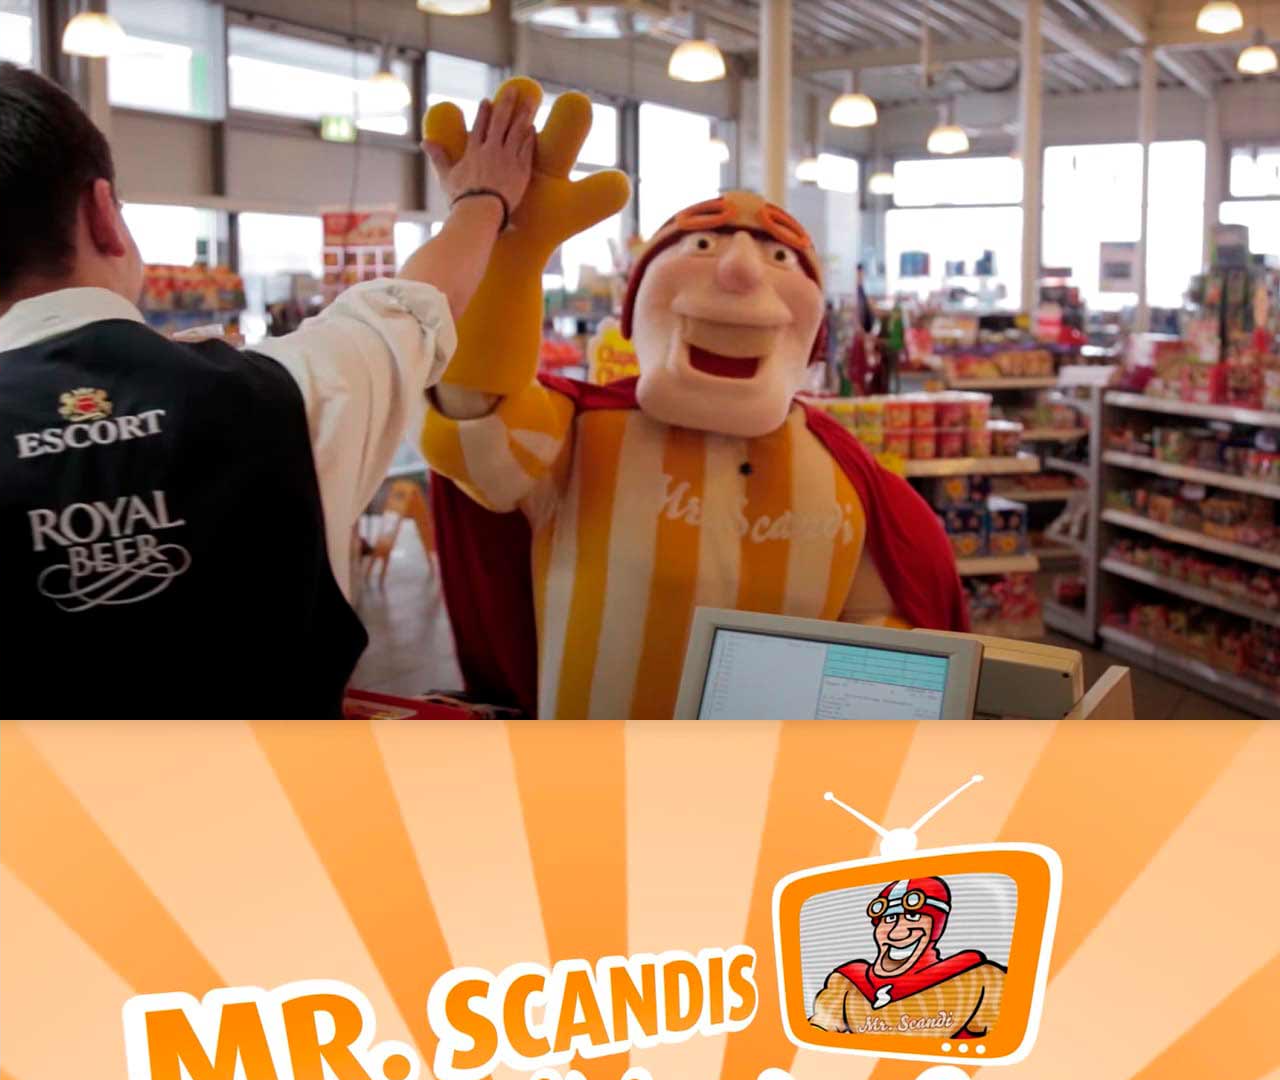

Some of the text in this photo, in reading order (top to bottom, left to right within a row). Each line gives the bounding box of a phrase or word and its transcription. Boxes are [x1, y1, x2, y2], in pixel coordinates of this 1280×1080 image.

[15, 409, 166, 459] ESCORT
[27, 490, 187, 552] ROYAL
[68, 534, 168, 577] BEER
[444, 954, 755, 1070] SCANDIS
[859, 1011, 953, 1033] Mr. Scandi
